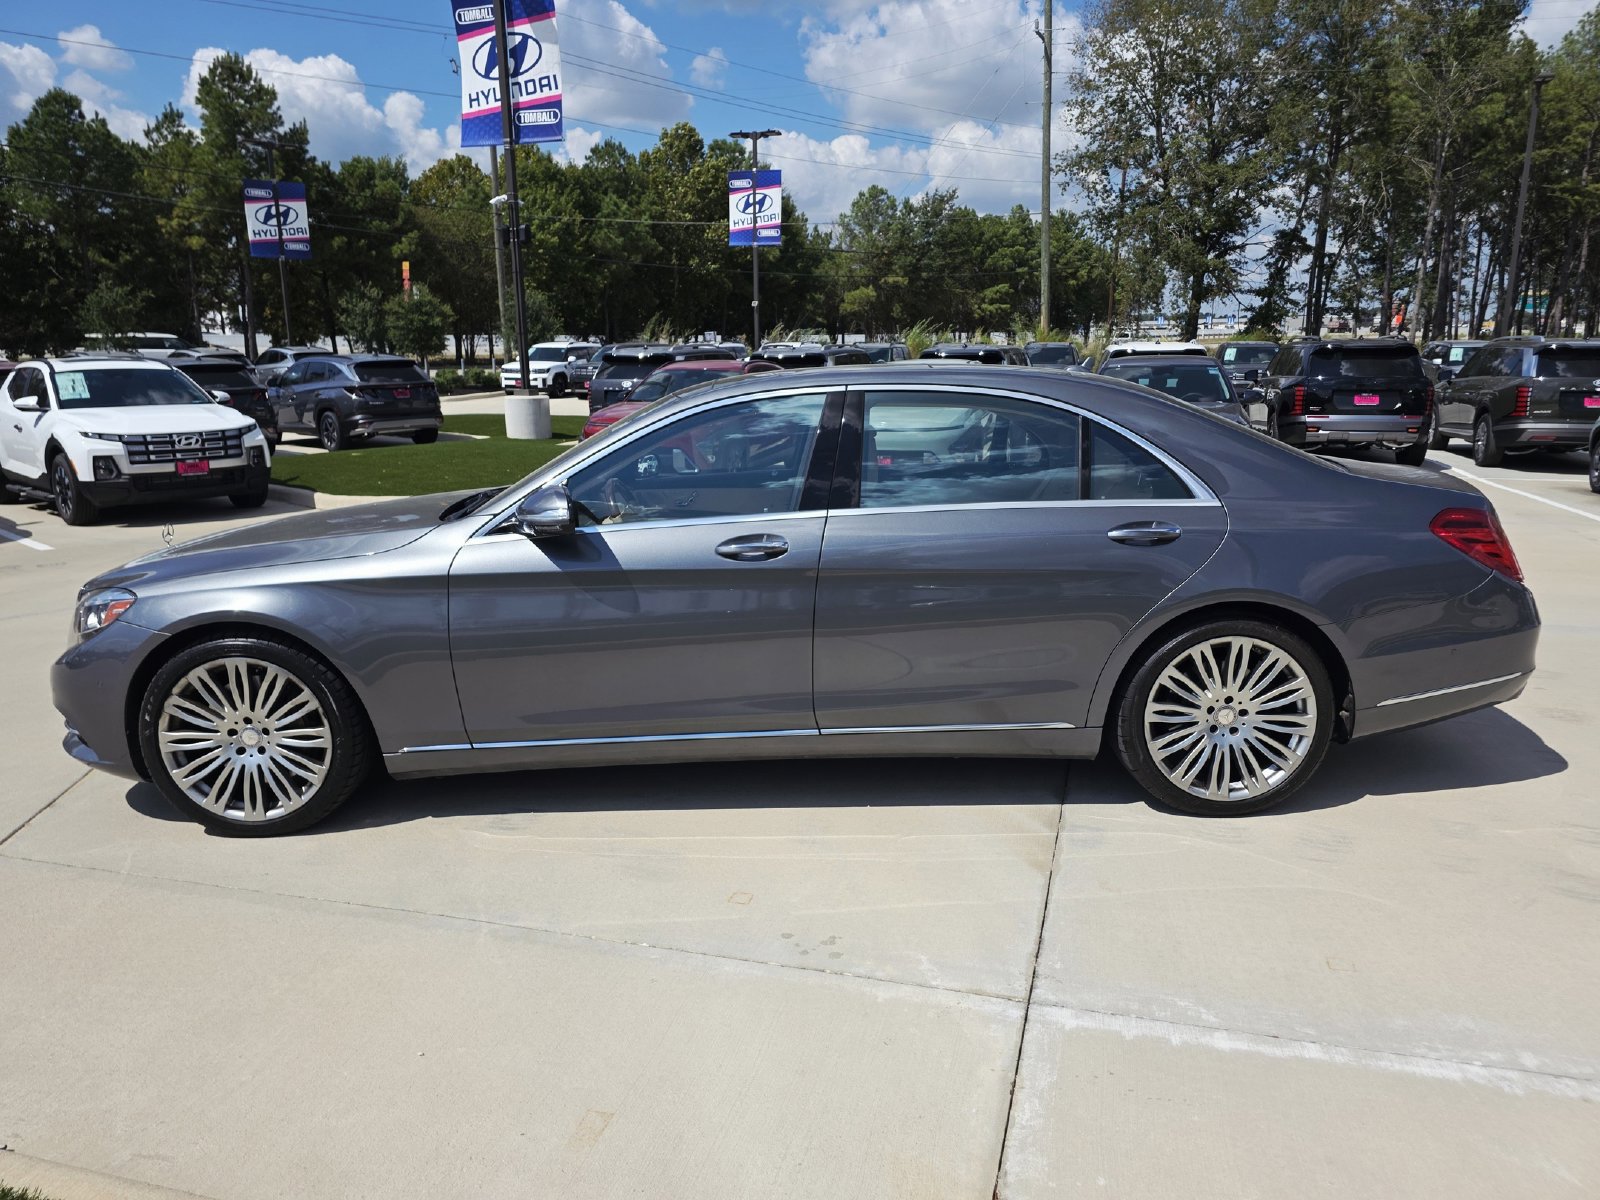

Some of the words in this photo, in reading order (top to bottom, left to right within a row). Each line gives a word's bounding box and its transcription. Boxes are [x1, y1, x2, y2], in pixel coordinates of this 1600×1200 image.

[460, 7, 494, 22] TOMBALL
[519, 111, 556, 124] TOMBALL
[733, 213, 780, 227] HYUNDAI
[253, 227, 308, 238] HYUNDAI
